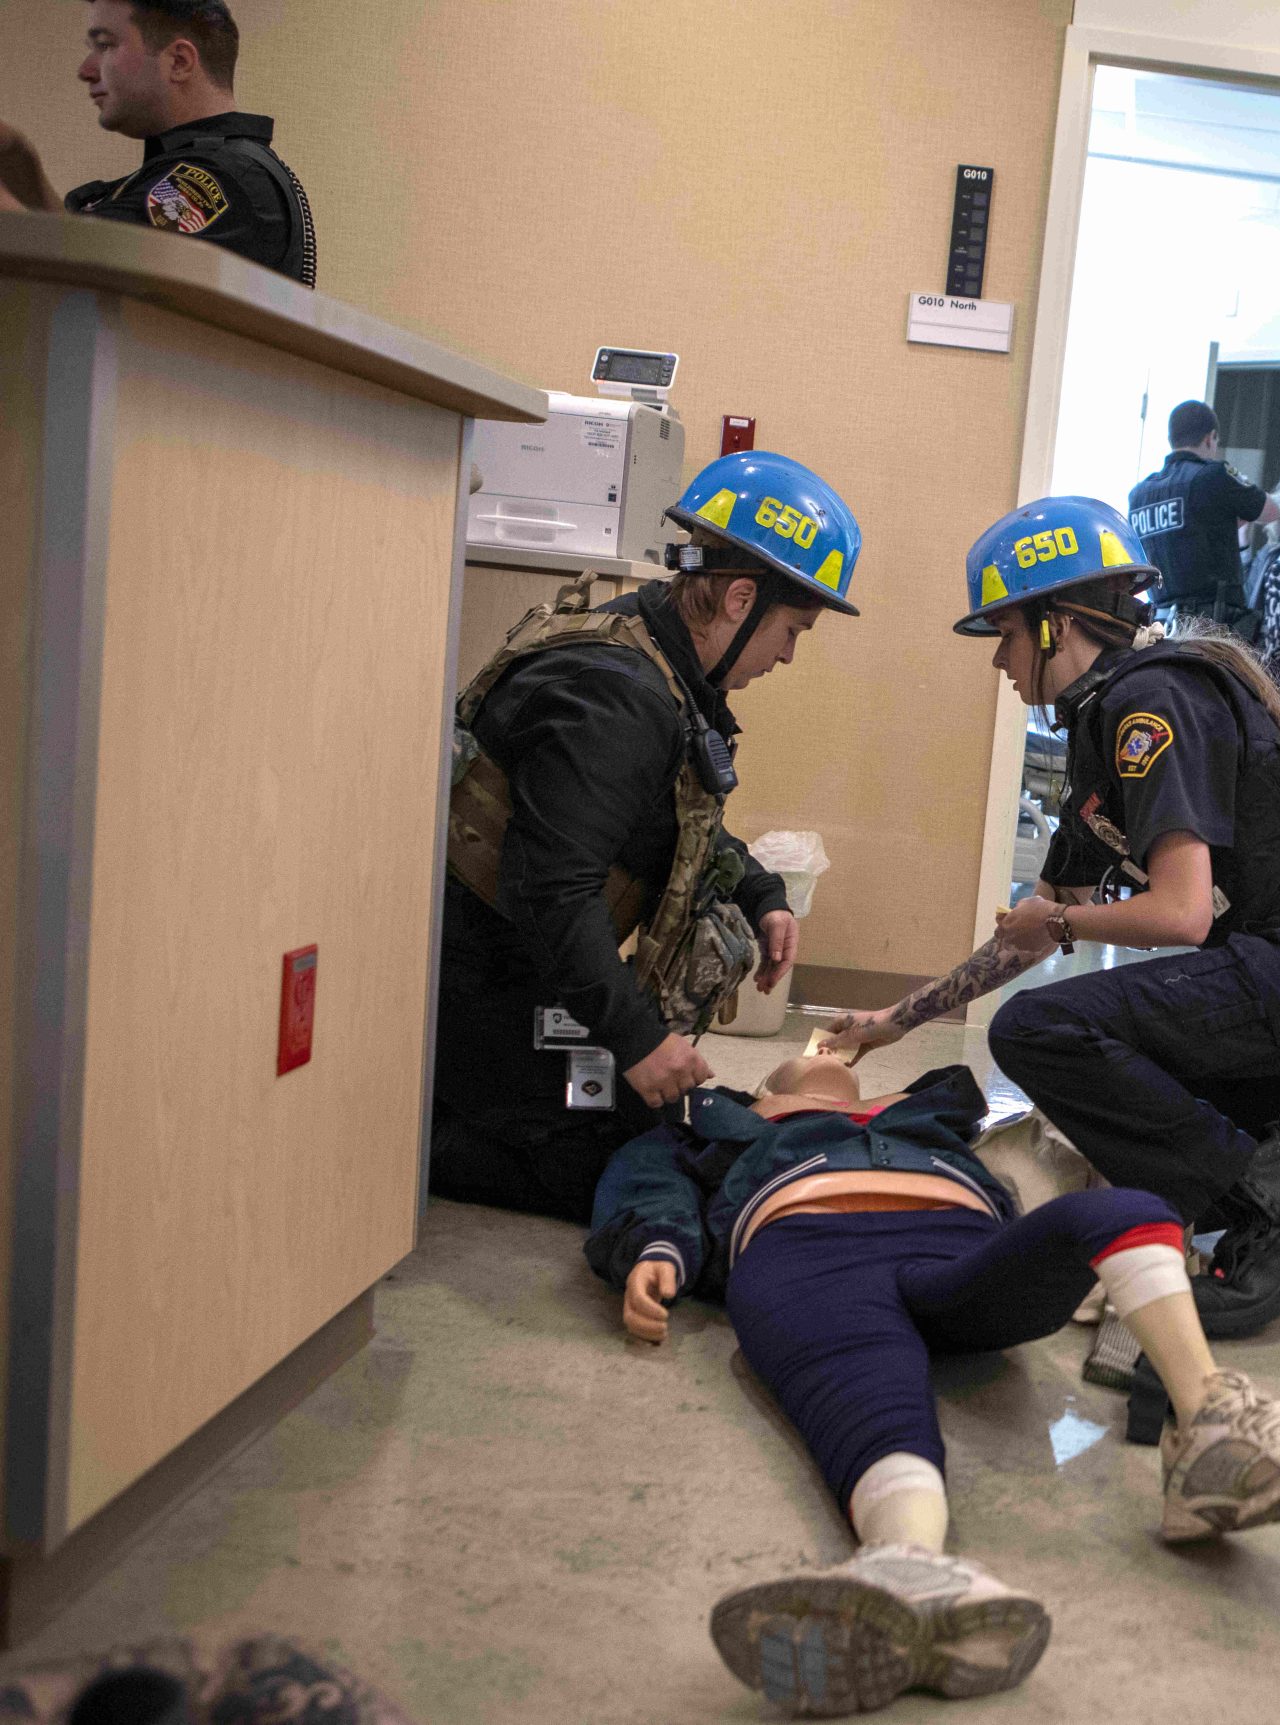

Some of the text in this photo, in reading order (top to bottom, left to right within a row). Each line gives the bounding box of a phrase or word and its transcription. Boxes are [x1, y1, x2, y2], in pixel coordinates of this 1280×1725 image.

[184, 168, 222, 203] POLICE
[963, 168, 988, 181] G010
[918, 295, 977, 311] G010 North
[754, 496, 819, 550] 650
[1131, 501, 1178, 535] POLICE
[1014, 526, 1079, 569] 650
